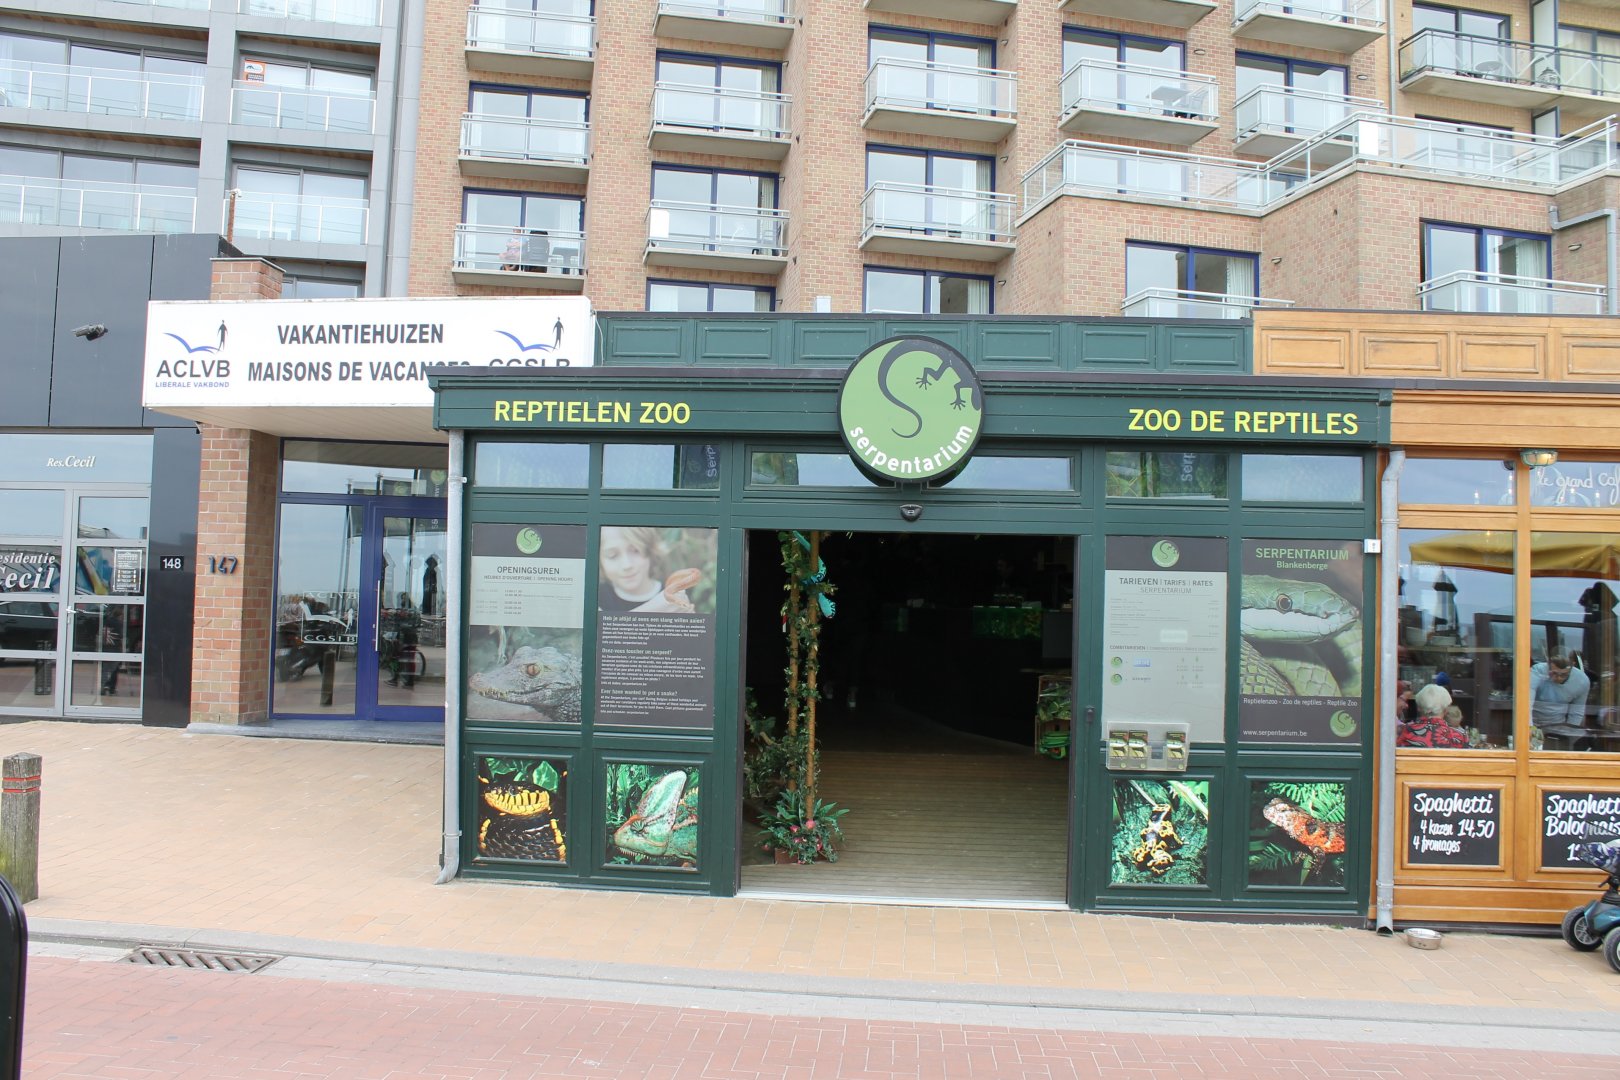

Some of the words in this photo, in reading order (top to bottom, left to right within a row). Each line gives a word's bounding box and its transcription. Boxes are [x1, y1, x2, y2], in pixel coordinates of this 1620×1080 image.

[277, 323, 444, 345] VAKANTIEHUIZEN
[156, 359, 231, 378] ACLVB
[248, 361, 332, 382] MAISONS
[338, 361, 363, 381] DE
[369, 360, 470, 381] VACAN
[494, 400, 631, 423] REPTIELEN
[639, 402, 691, 425] ZOO
[1128, 408, 1181, 432] ZOO
[1190, 410, 1225, 433] DE
[1234, 411, 1358, 435] REPTILES
[850, 425, 973, 474] serpentarium
[162, 558, 181, 569] 148
[1255, 547, 1349, 560] SERPENTARIUM
[208, 554, 238, 574] 147
[497, 566, 560, 575] OPENINGSUREN
[1276, 560, 1328, 571] Blankenberge
[1119, 577, 1159, 585] TARIEVEN
[1326, 699, 1346, 707] Reptile
[1243, 729, 1308, 737] www.serpentarium.be
[1413, 792, 1494, 817] Spaghetti
[1546, 793, 1620, 819] Spaghett
[1420, 819, 1427, 834] 4
[1429, 819, 1453, 836] kazen
[1457, 818, 1495, 838] 14,50
[1544, 815, 1620, 840] Bolognais
[1412, 835, 1420, 850] 4
[1421, 834, 1461, 855] fromages
